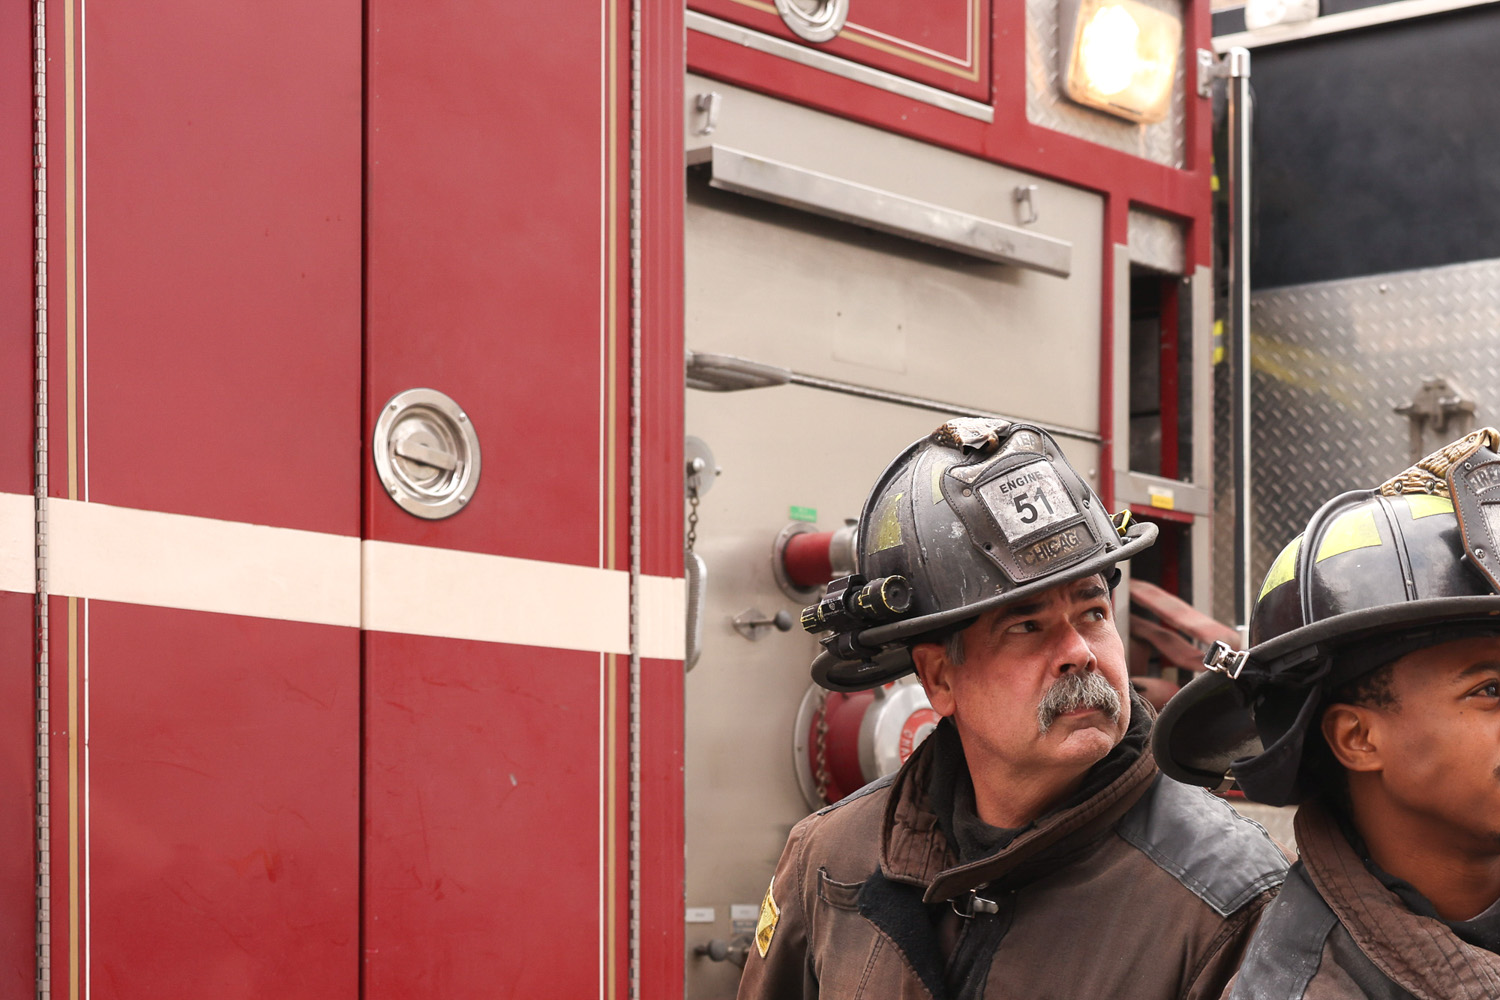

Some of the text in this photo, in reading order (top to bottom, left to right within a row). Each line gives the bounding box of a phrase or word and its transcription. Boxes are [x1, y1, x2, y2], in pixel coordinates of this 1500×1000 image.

[999, 471, 1044, 494] ENGINE
[1013, 487, 1055, 524] 51
[1023, 532, 1081, 567] CHICAG
